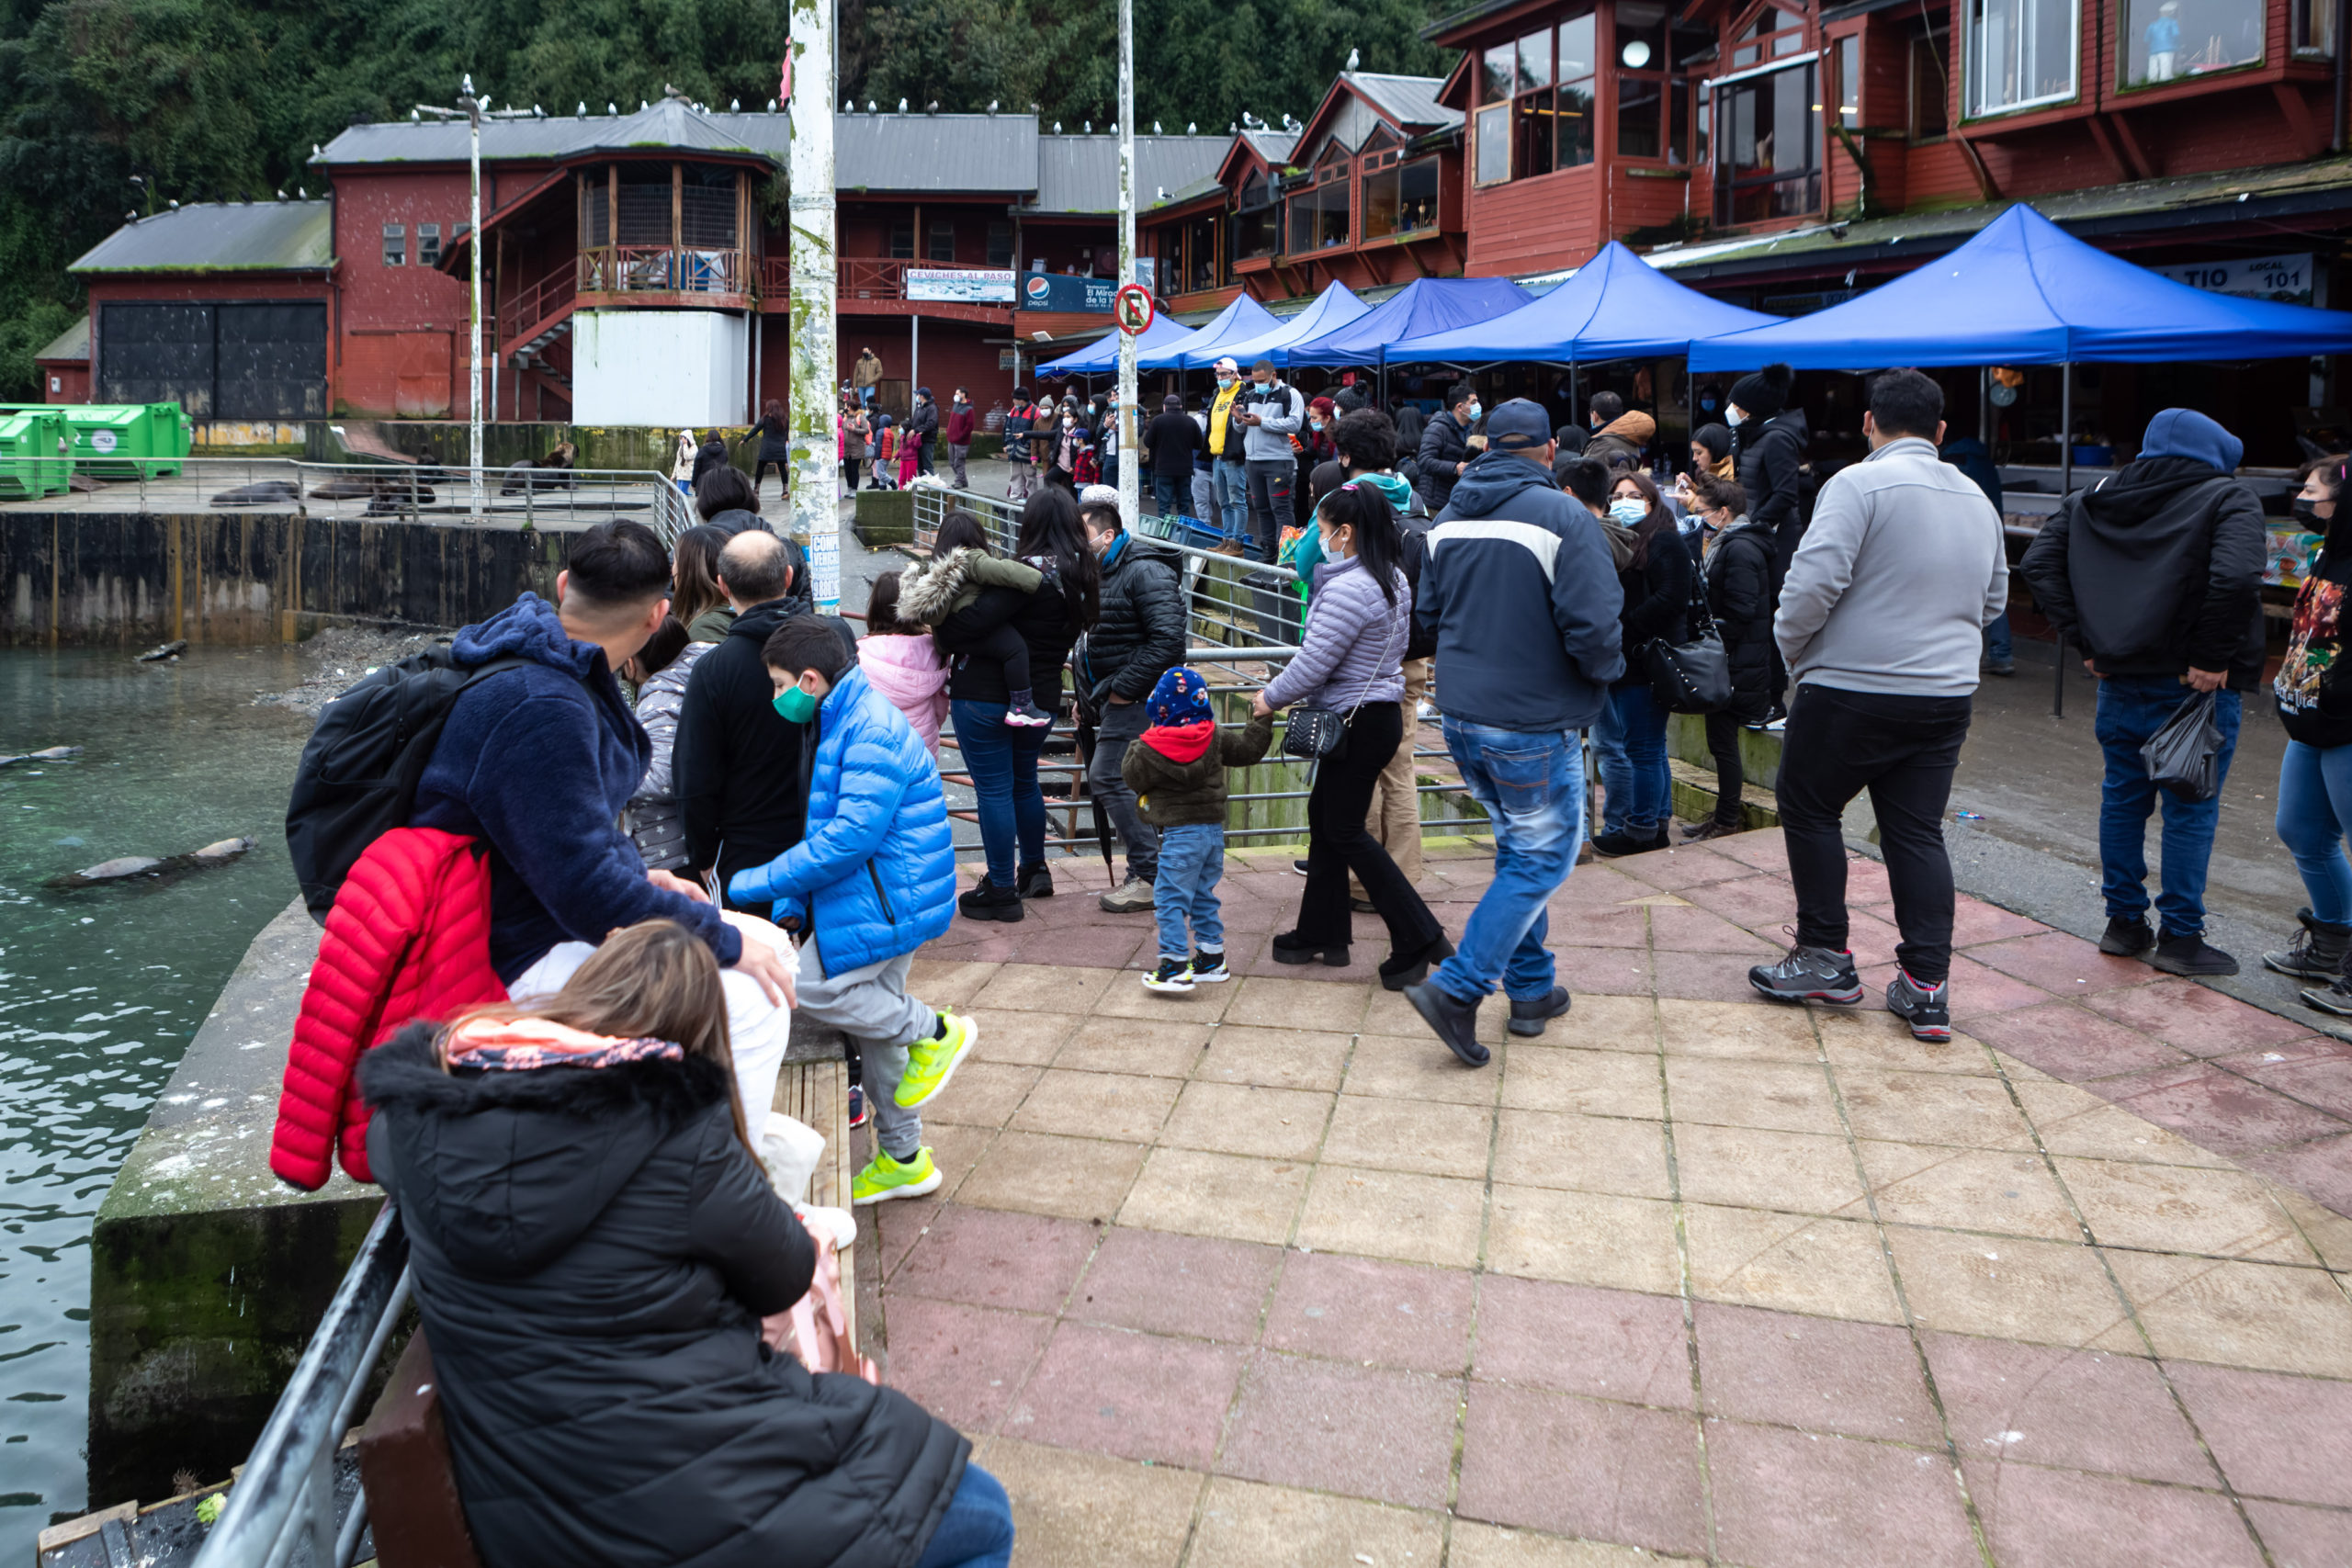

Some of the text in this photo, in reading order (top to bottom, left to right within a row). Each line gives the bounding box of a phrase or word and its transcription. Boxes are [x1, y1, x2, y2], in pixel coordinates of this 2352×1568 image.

[2248, 261, 2285, 272] LOCAL
[910, 270, 1012, 280] CEVICHES AL PASO
[2184, 268, 2228, 288] TIO
[2264, 271, 2301, 288] 101
[1087, 288, 1119, 297] El Mirad
[1027, 299, 1048, 308] pepsi
[1085, 296, 1097, 304] de
[1099, 296, 1107, 304] la
